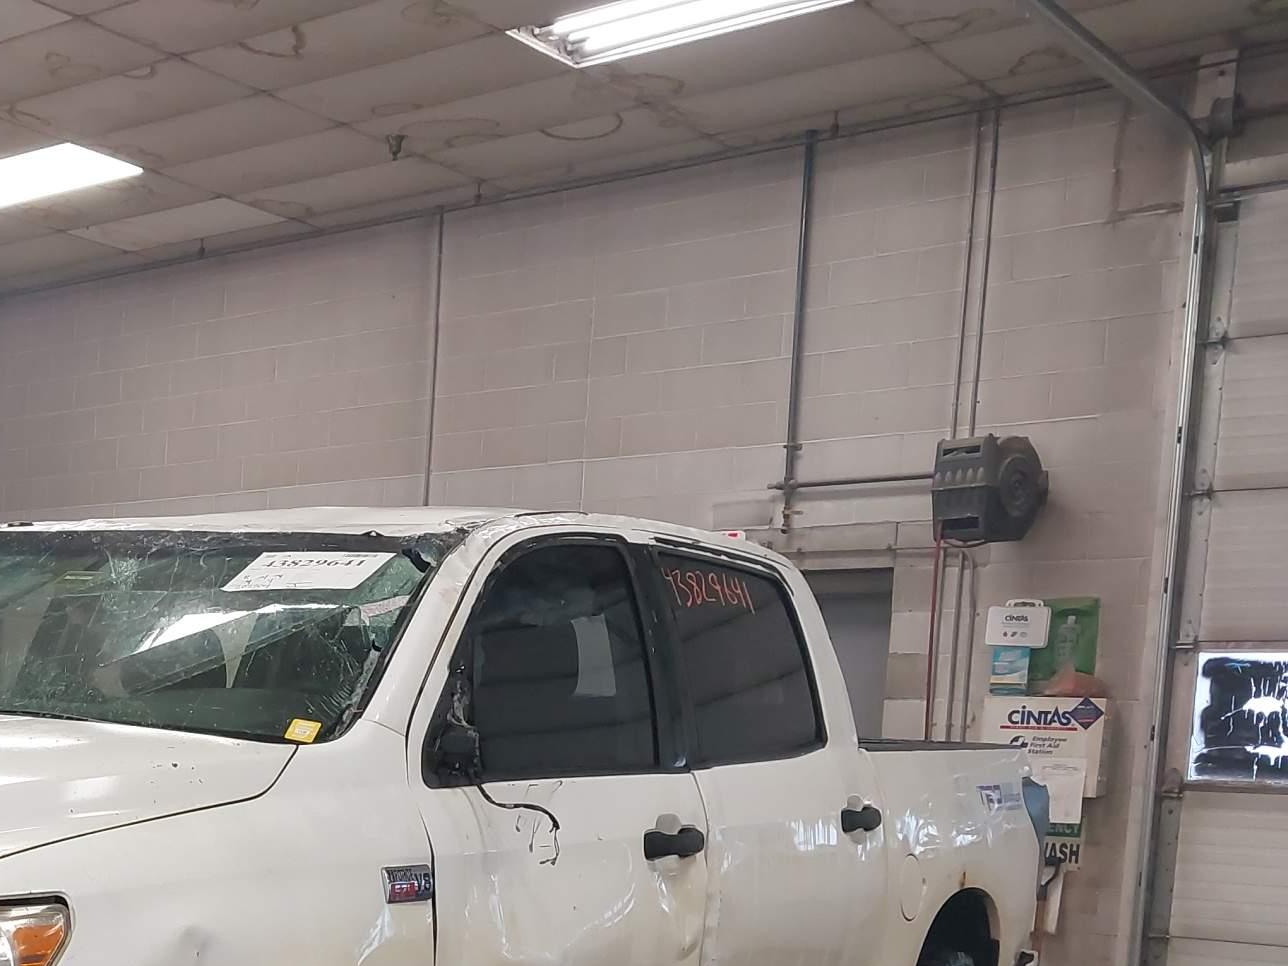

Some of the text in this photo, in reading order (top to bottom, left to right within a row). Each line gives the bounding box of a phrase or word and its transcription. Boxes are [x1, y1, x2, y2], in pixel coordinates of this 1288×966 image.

[263, 558, 367, 569] 43829641
[660, 567, 756, 615] 43829641
[1007, 704, 1073, 727] CINTAS
[1032, 736, 1068, 744] Employee
